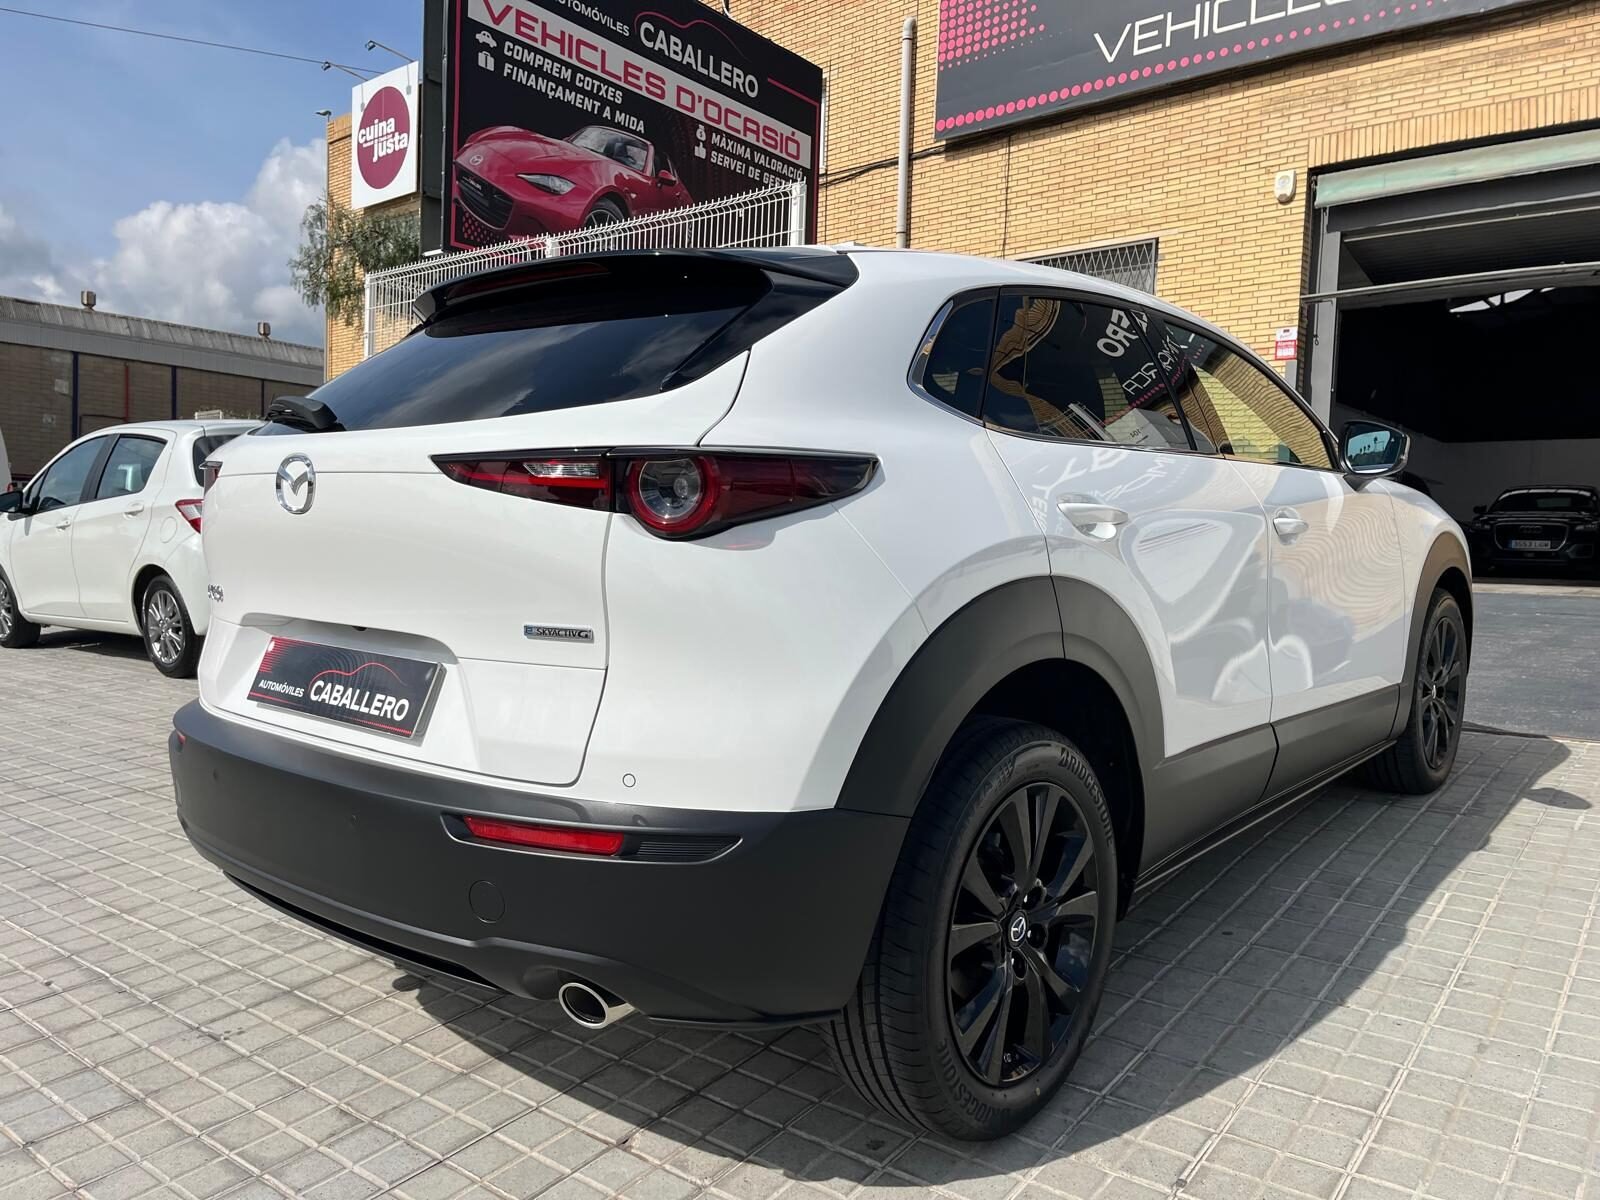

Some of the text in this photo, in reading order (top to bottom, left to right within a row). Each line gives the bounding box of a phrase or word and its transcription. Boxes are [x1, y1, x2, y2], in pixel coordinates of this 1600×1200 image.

[555, 0, 759, 98] TOMÓVILES CABALLERO
[1094, 0, 1352, 63] VEHICL
[482, 0, 801, 161] VEHICLES D'OCASIÓ
[503, 41, 623, 105] COMPREM COTXES
[503, 63, 646, 134] FINANÇAMENT A MIDA
[358, 117, 395, 144] cuina
[372, 131, 408, 163] justa
[711, 132, 803, 181] MÀXIMA VALORACIÓ
[710, 150, 746, 175] SERVEI
[748, 165, 761, 181] DE
[258, 679, 410, 721] AUTOMÓVILES CABALLERO
[1057, 746, 1114, 847] BRIDGESTONE
